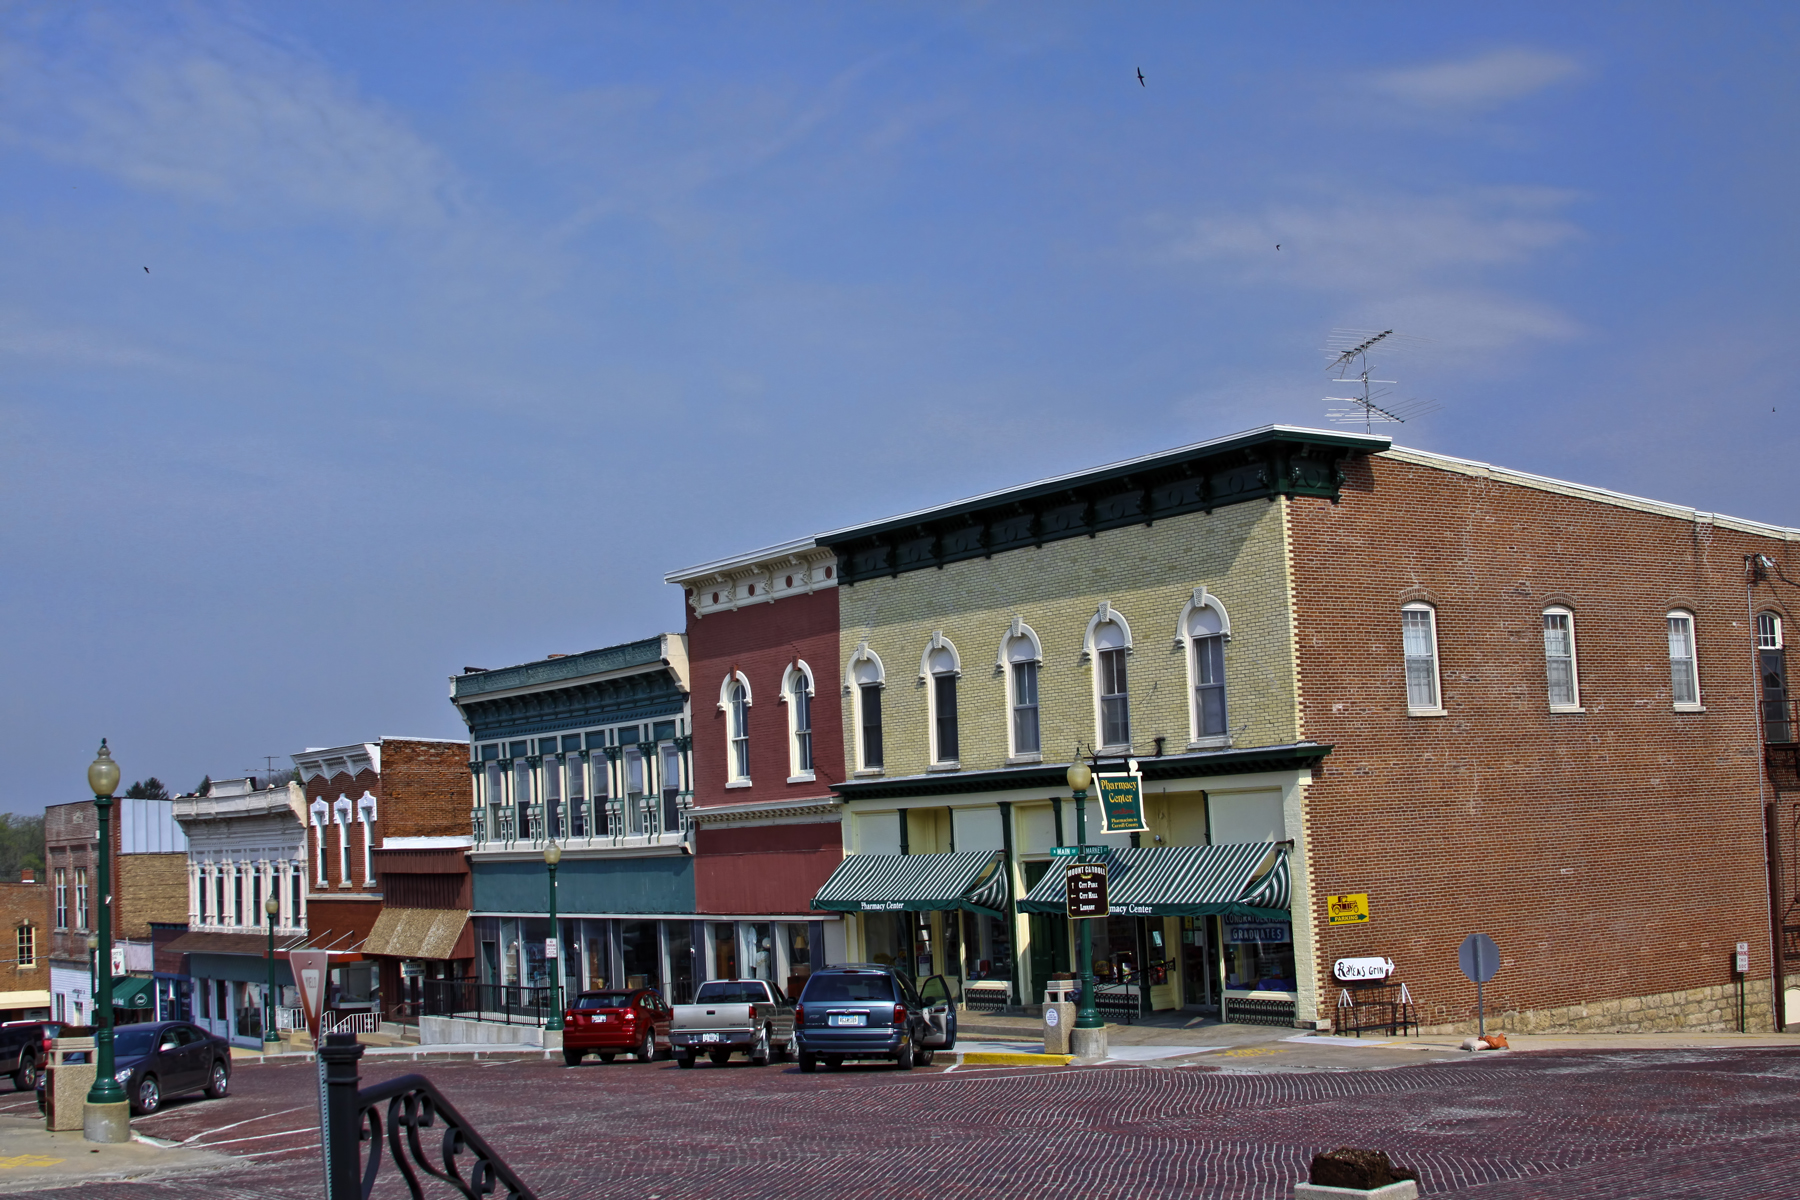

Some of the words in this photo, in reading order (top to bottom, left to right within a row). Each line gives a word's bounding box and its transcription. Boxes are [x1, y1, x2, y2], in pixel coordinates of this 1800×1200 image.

[1101, 780, 1137, 791] Pharmacy
[1109, 793, 1133, 804] Center
[1067, 867, 1084, 877] MOUNT
[1085, 866, 1106, 876] CARROLL
[861, 901, 885, 911] Pharmacy
[886, 901, 904, 909] Center
[1109, 905, 1127, 915] macy
[1128, 903, 1153, 913] Center
[1232, 928, 1282, 939] GRADUATES
[305, 976, 317, 988] YIELD
